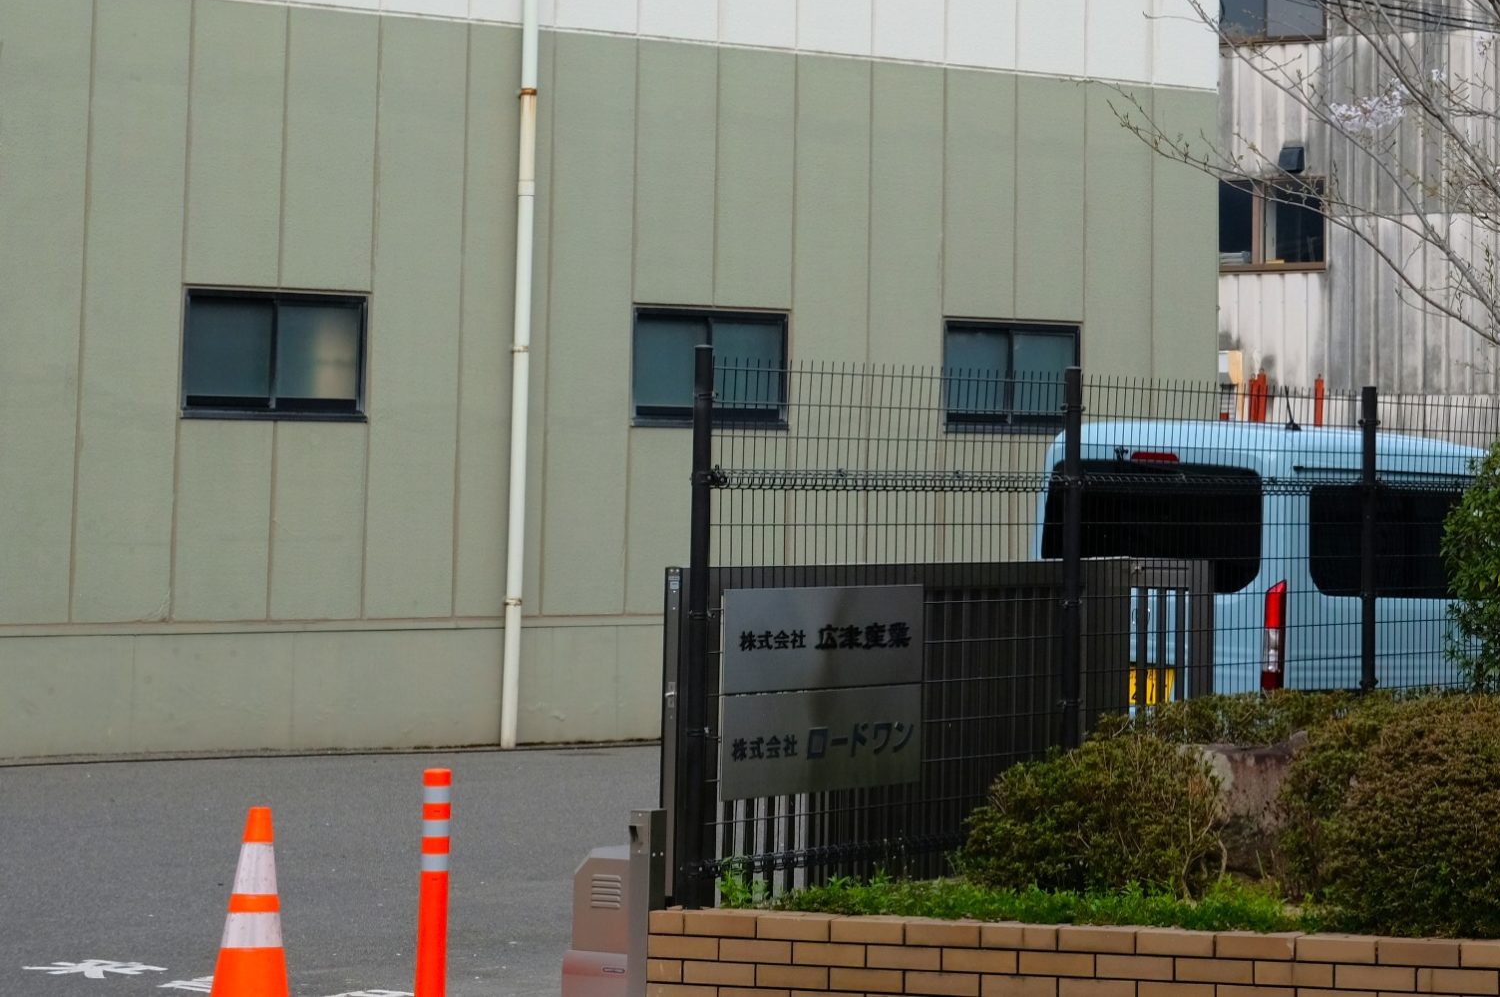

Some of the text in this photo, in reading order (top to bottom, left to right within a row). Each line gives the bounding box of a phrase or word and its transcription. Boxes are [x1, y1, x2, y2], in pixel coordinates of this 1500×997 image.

[739, 630, 806, 652] 株式会社
[731, 721, 915, 762] 株式会社 ロードワン
